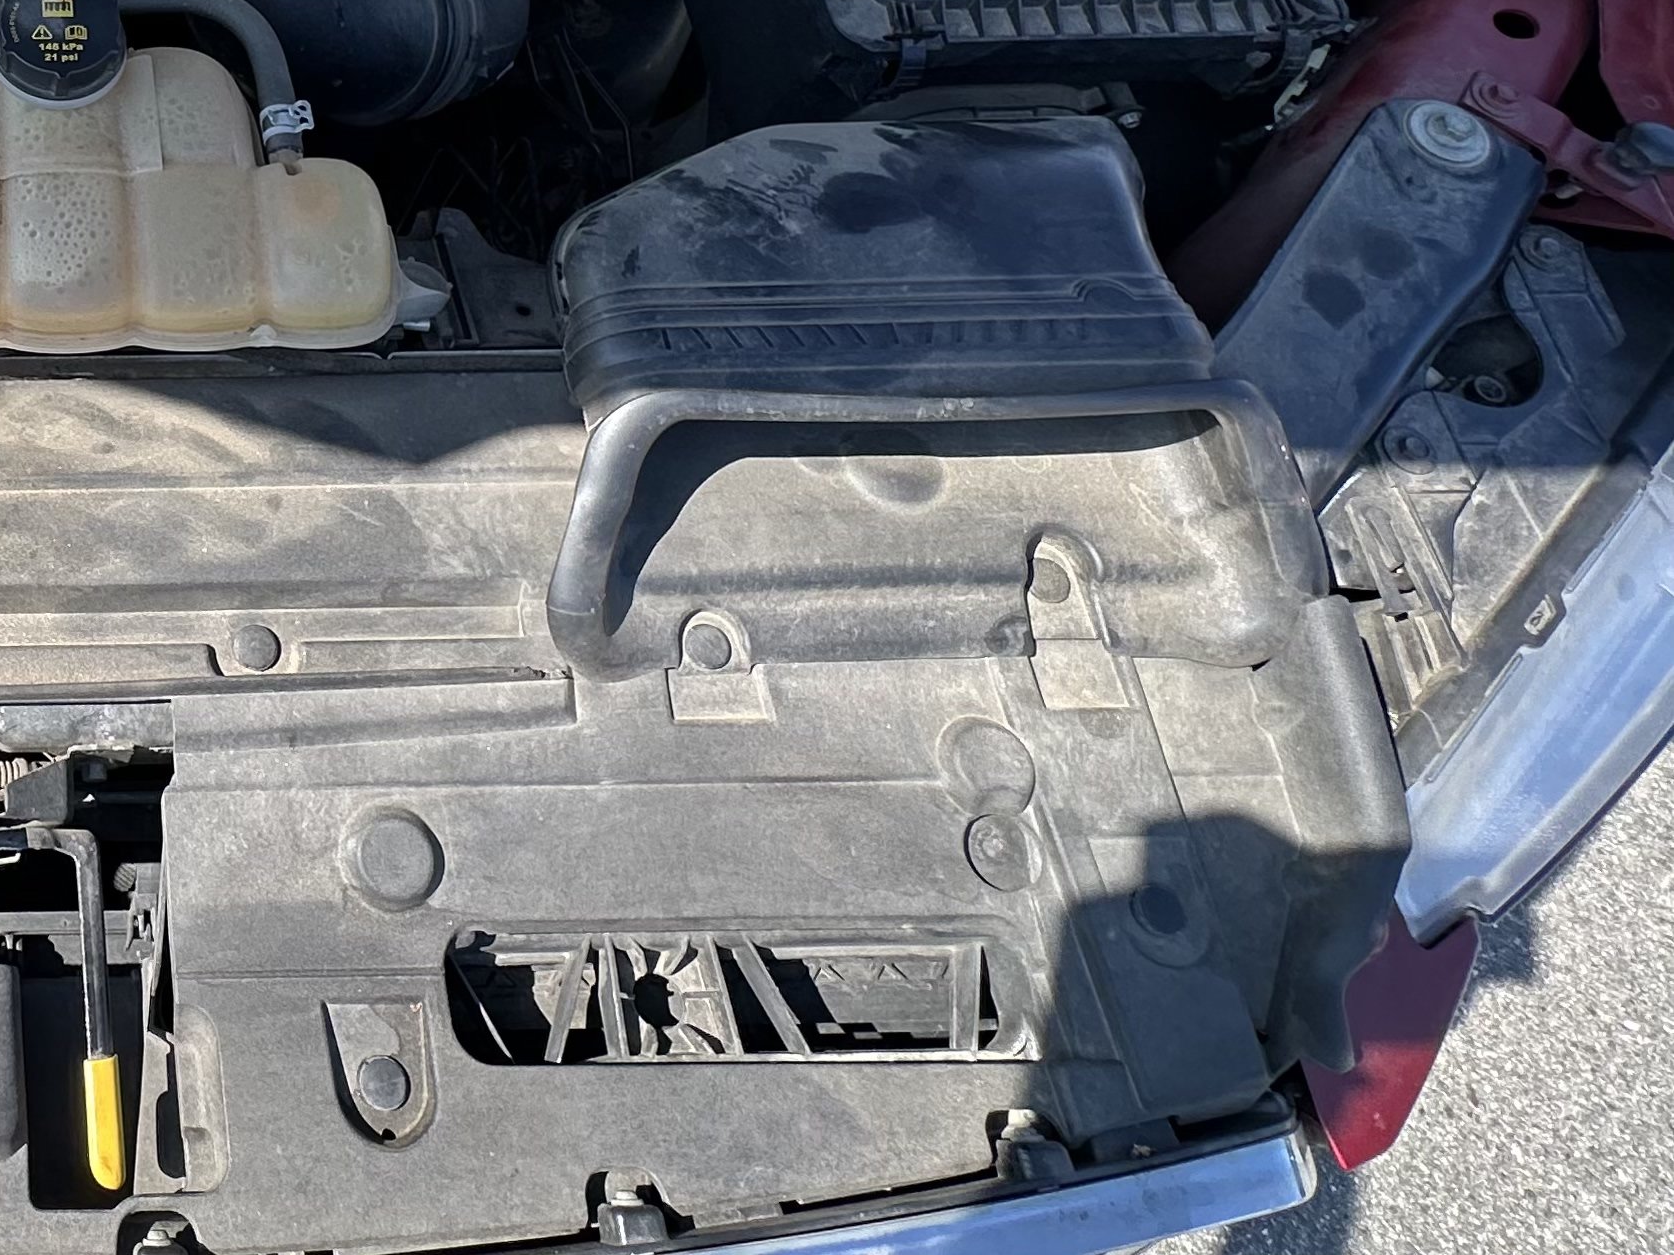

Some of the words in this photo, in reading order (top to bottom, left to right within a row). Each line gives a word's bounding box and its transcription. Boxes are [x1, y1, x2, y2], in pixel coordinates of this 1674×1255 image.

[61, 42, 84, 51] kPa
[44, 52, 58, 62] 21
[61, 53, 79, 63] psi
